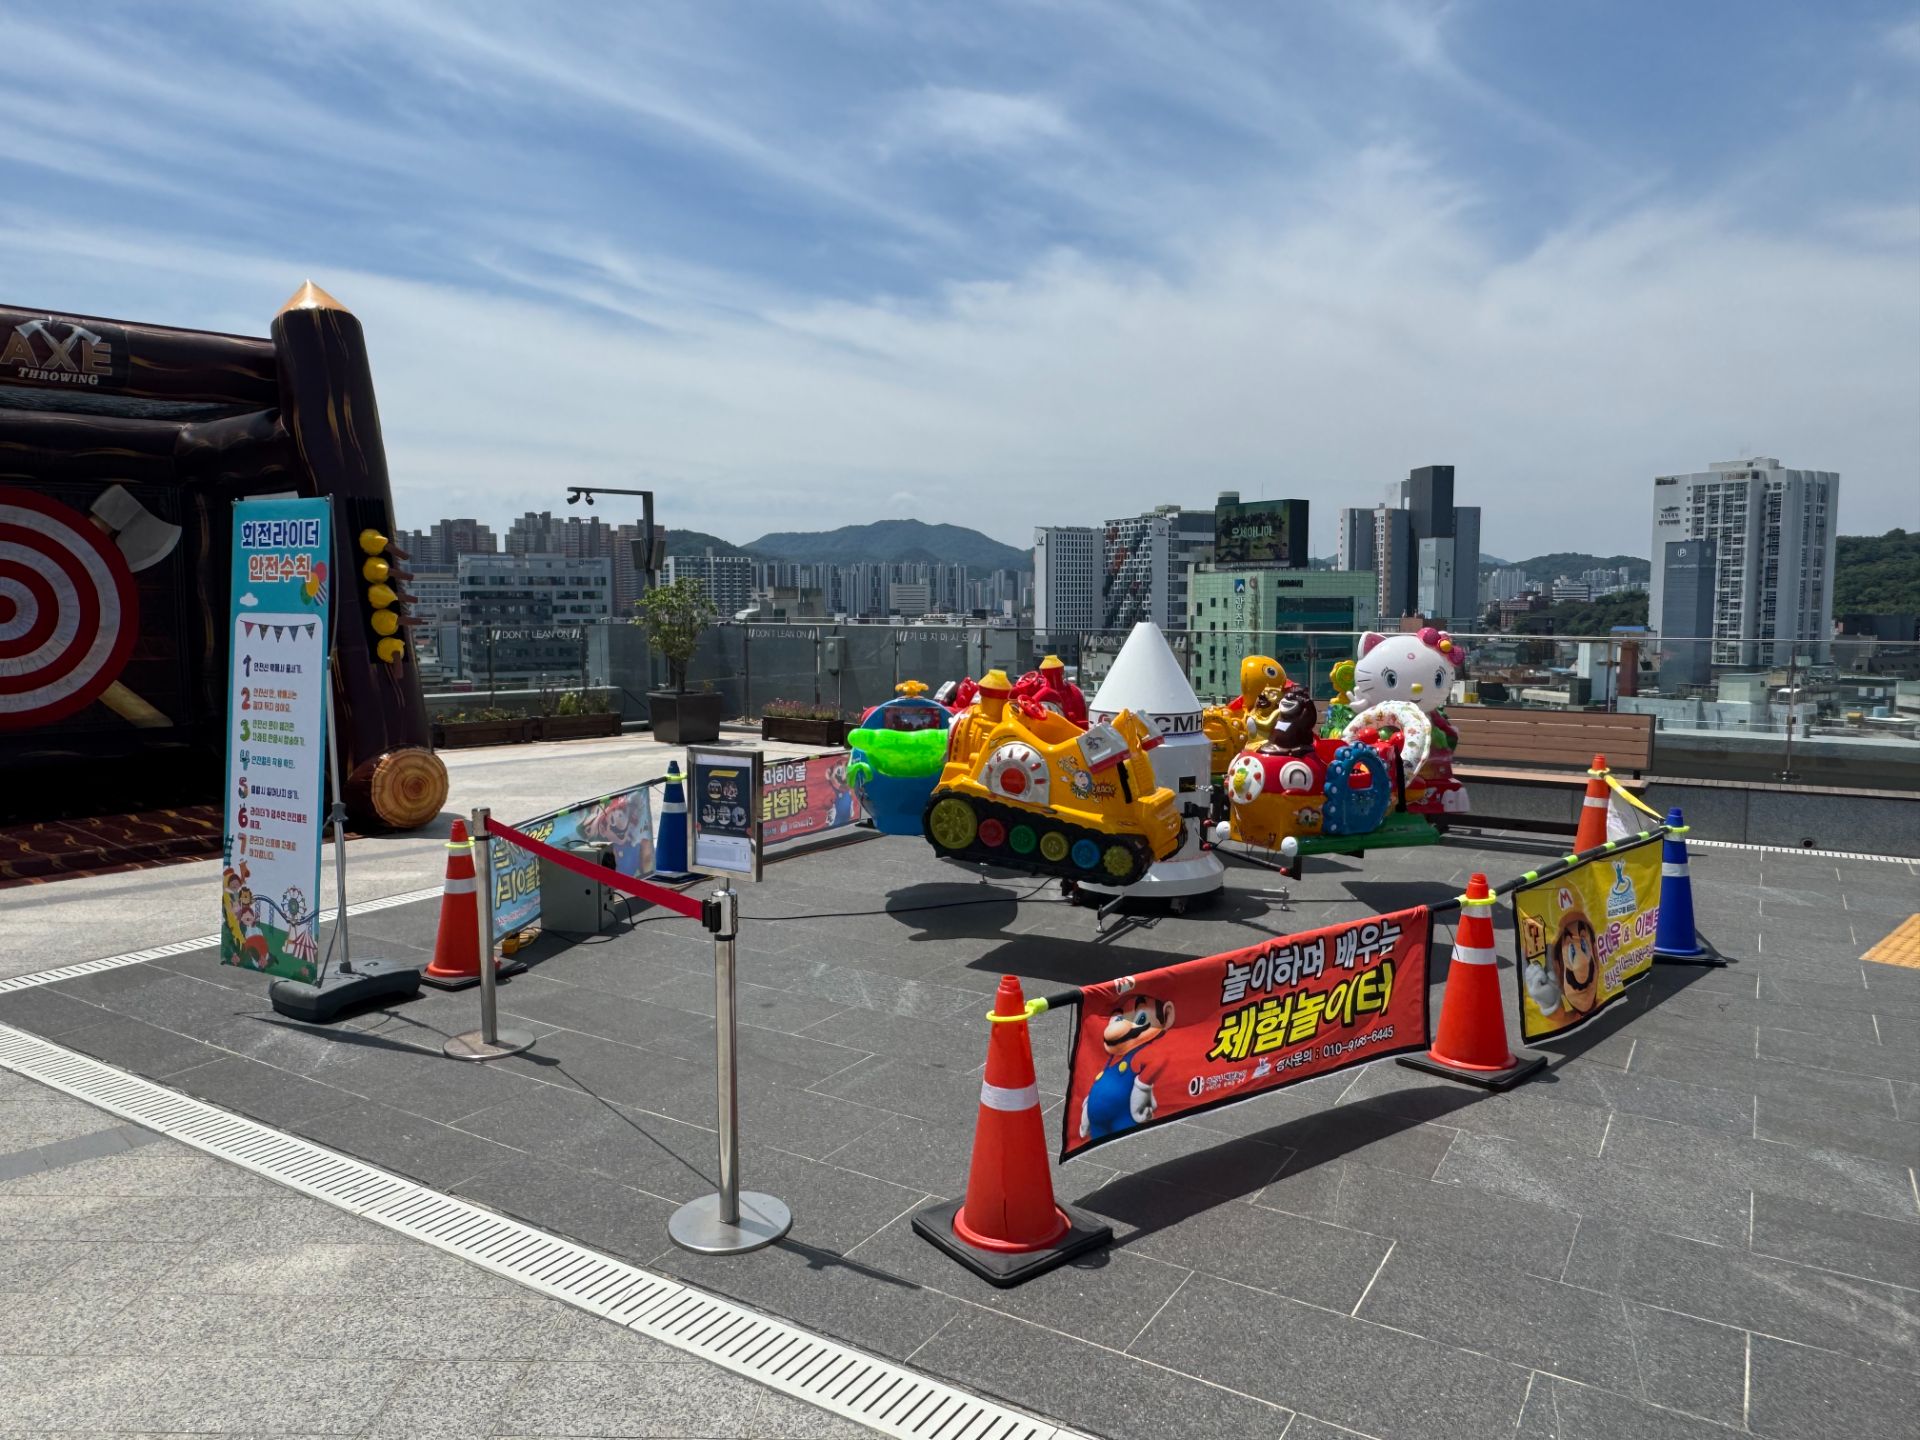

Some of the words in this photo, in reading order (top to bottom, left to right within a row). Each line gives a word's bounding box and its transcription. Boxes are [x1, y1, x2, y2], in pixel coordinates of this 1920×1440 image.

[0, 319, 112, 376] AXE
[18, 367, 98, 385] THROWING
[241, 519, 320, 548] 회전라이더
[249, 554, 311, 582] 안전수칙
[243, 654, 252, 678] 1
[241, 687, 250, 710] 2
[240, 719, 250, 741] 3
[240, 749, 250, 771] 4
[238, 777, 248, 799] 5
[238, 807, 248, 828] 6
[238, 833, 247, 855] 7
[1221, 940, 1325, 1004] 놀이하며
[1334, 921, 1402, 968] 배우는
[1208, 961, 1396, 1061] 체험놀이터
